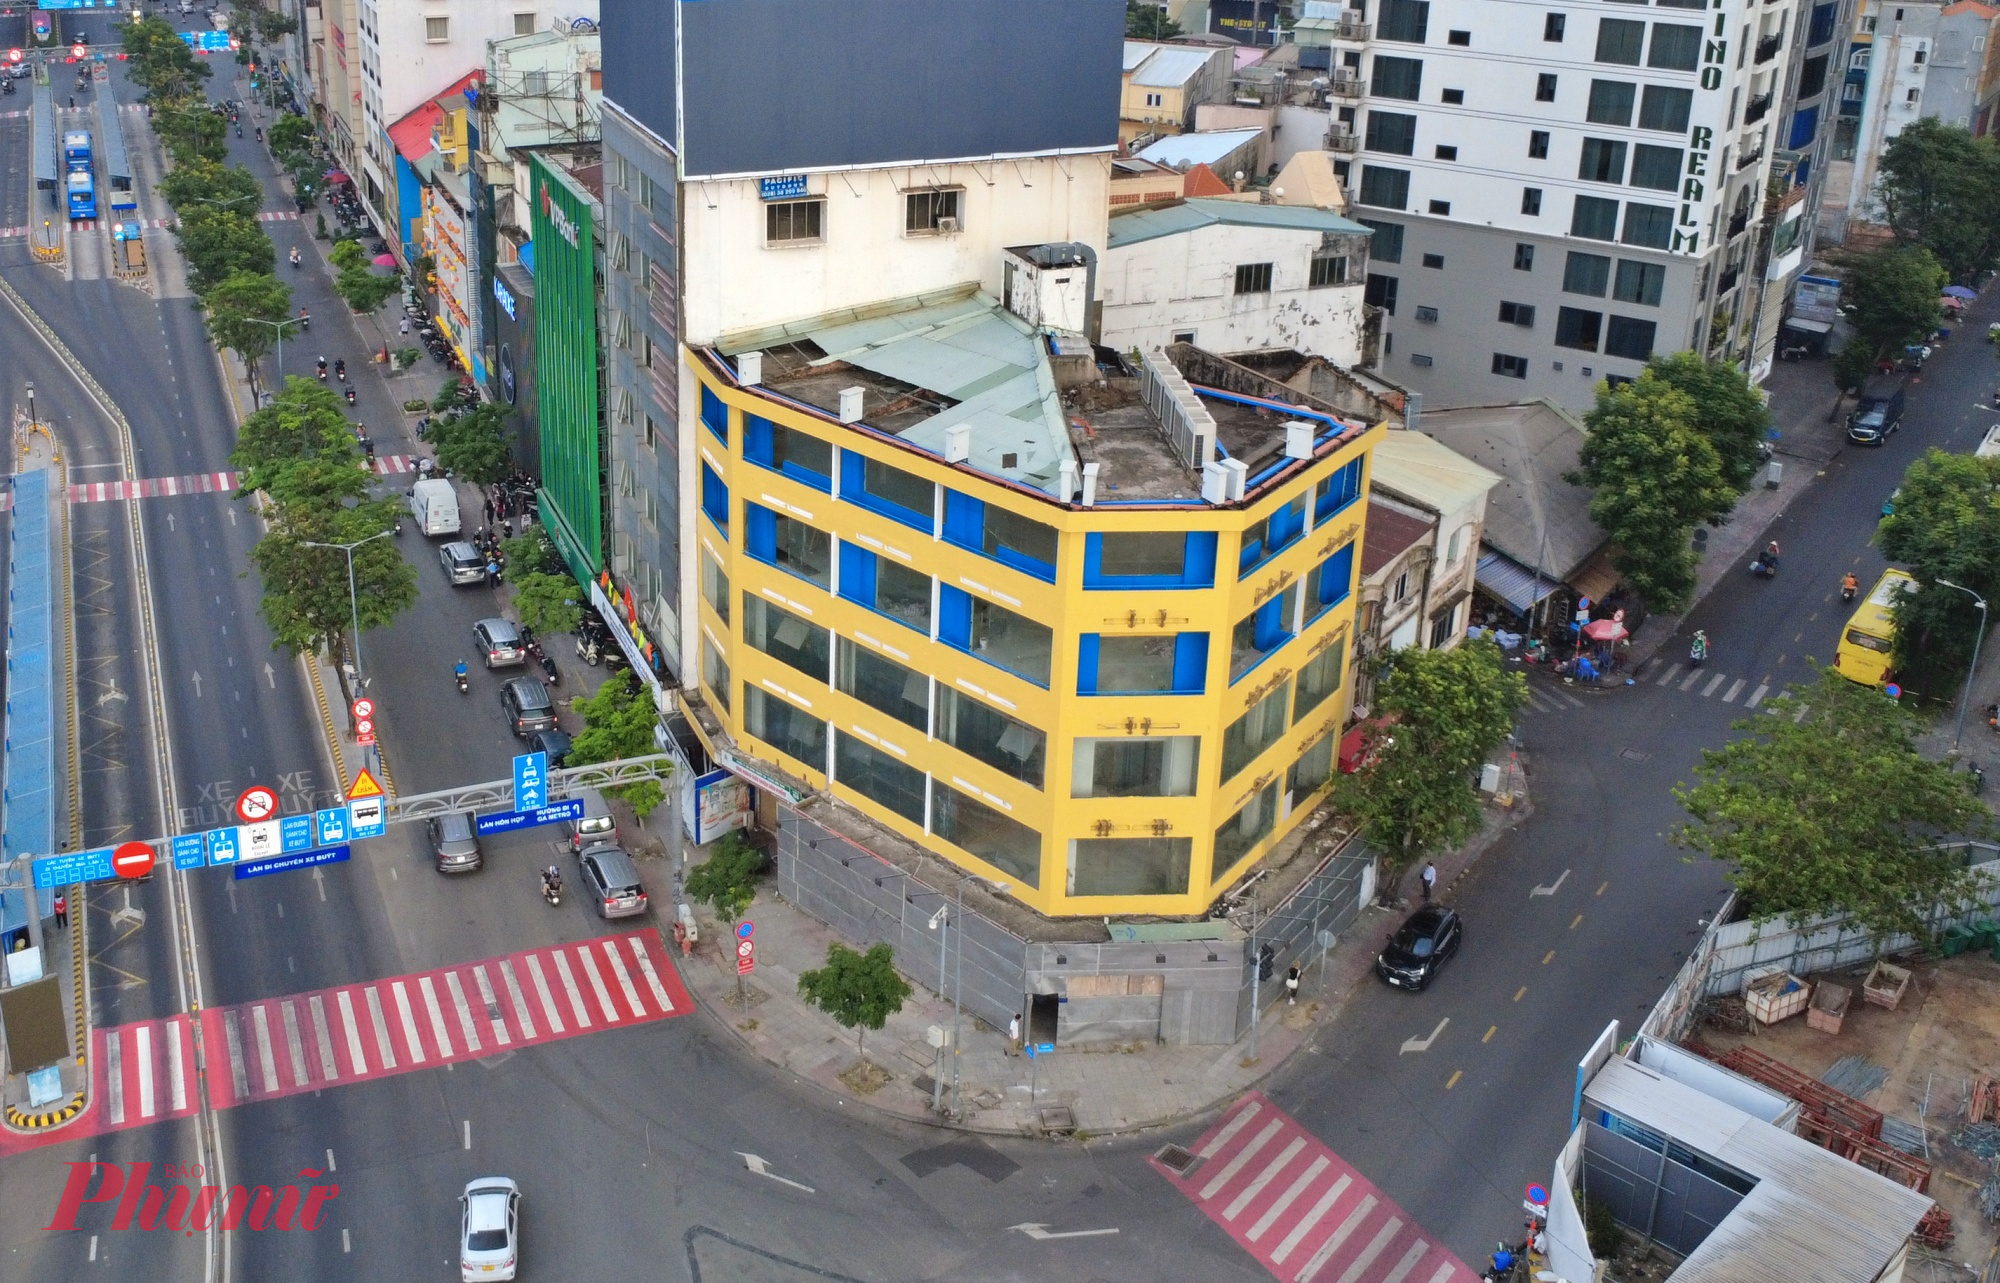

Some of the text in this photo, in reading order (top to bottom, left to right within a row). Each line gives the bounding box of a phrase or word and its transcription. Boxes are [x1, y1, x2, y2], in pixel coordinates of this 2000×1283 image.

[765, 175, 803, 184] PACIFIC
[1672, 125, 1713, 254] REALM
[549, 197, 581, 250] VPBank
[277, 770, 316, 793] XE
[196, 780, 236, 803] XE
[548, 811, 571, 820] METRO
[480, 821, 494, 829] LÀN
[247, 866, 263, 874] LÀN
